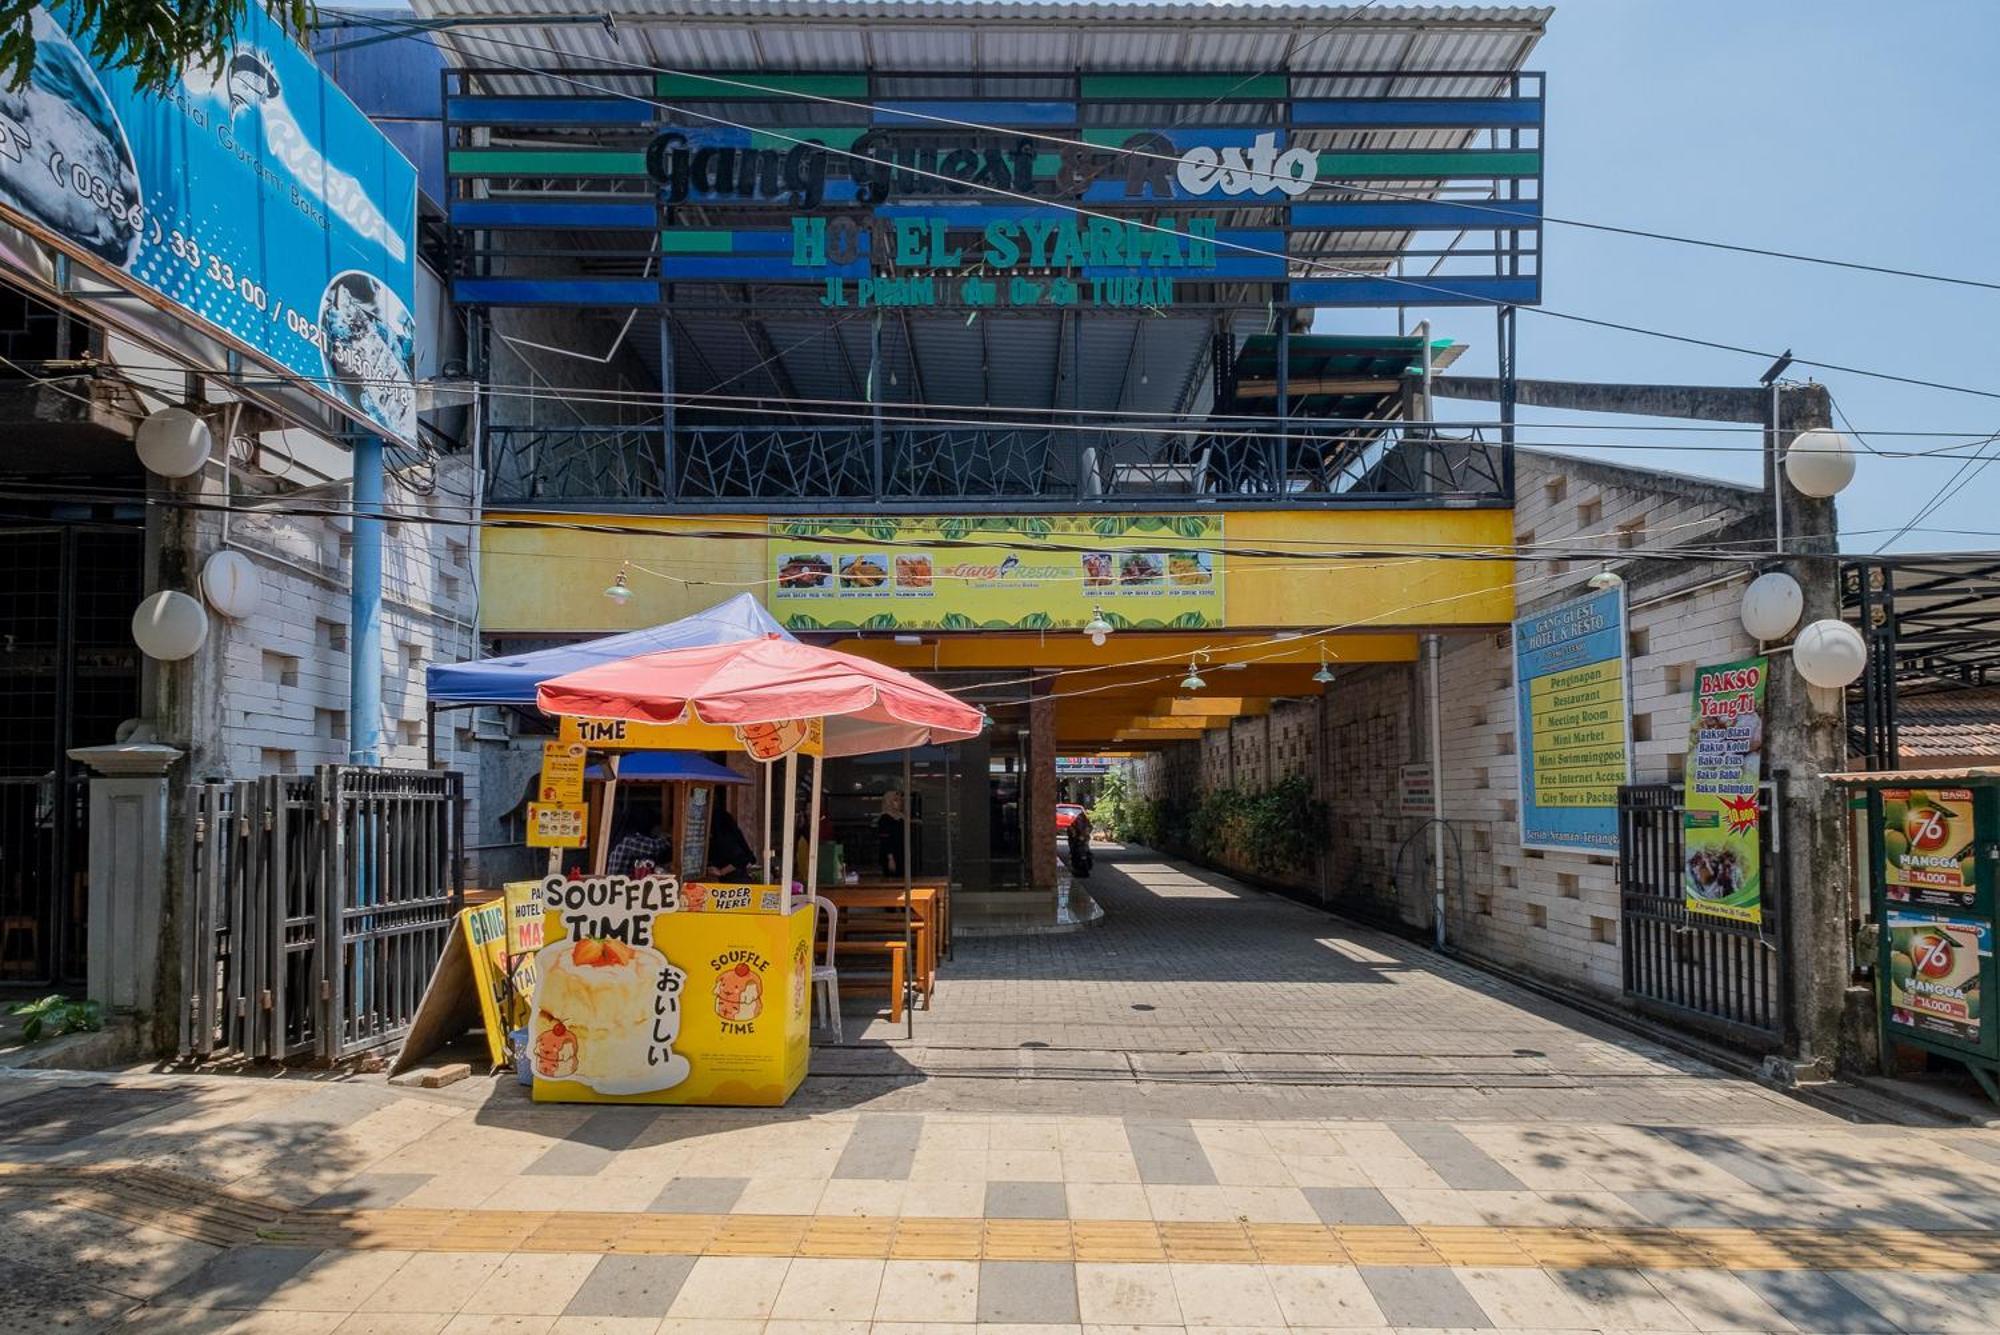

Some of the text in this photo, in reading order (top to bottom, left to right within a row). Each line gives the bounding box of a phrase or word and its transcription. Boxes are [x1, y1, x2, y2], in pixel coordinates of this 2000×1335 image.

[646, 131, 827, 210] Gang
[1123, 130, 1321, 196] Resto
[291, 184, 331, 230] Bakar
[985, 216, 1217, 269] SYARIAH
[171, 230, 201, 267] 33
[207, 254, 236, 290] 33
[241, 278, 268, 312] 00
[287, 309, 329, 353] 0821
[819, 276, 849, 307] JL
[1090, 276, 1174, 307] TUBAN
[1535, 603, 1595, 633] GANG GUEST
[1529, 629, 1557, 649] HOTEL
[1571, 614, 1604, 637] RESTO
[1550, 670, 1602, 689] Penginapan
[1701, 668, 1760, 693] BAKSO
[1553, 690, 1600, 707] Restaurant
[1547, 710, 1609, 727] Meeting Room
[577, 719, 627, 741] TIME
[1552, 731, 1605, 745] Mini Market
[1700, 727, 1750, 740] Bakso Biasa
[1538, 749, 1625, 766] Mini Swimmingpool
[1699, 743, 1724, 753] Bakso
[1698, 756, 1722, 766] Bakso
[1541, 771, 1626, 785] Free Internet Access
[1696, 770, 1718, 780] Bakso
[1695, 783, 1717, 793] Bakso
[1542, 793, 1557, 806] City
[1911, 810, 1942, 847] 76
[1899, 854, 1960, 868] MANGGA
[546, 878, 676, 911] SOUFFLE
[711, 887, 752, 899] ORDER
[716, 897, 752, 909] HERE!
[515, 903, 541, 918] HOTEL
[470, 906, 505, 946] GANG
[519, 922, 544, 948] MA
[566, 914, 652, 947] TIME
[710, 950, 771, 972] SOUFFLE
[1917, 938, 1947, 972] 76
[1904, 977, 1964, 1000] MANGGA
[647, 967, 682, 1066] おいしい
[720, 1021, 756, 1035] TIME
